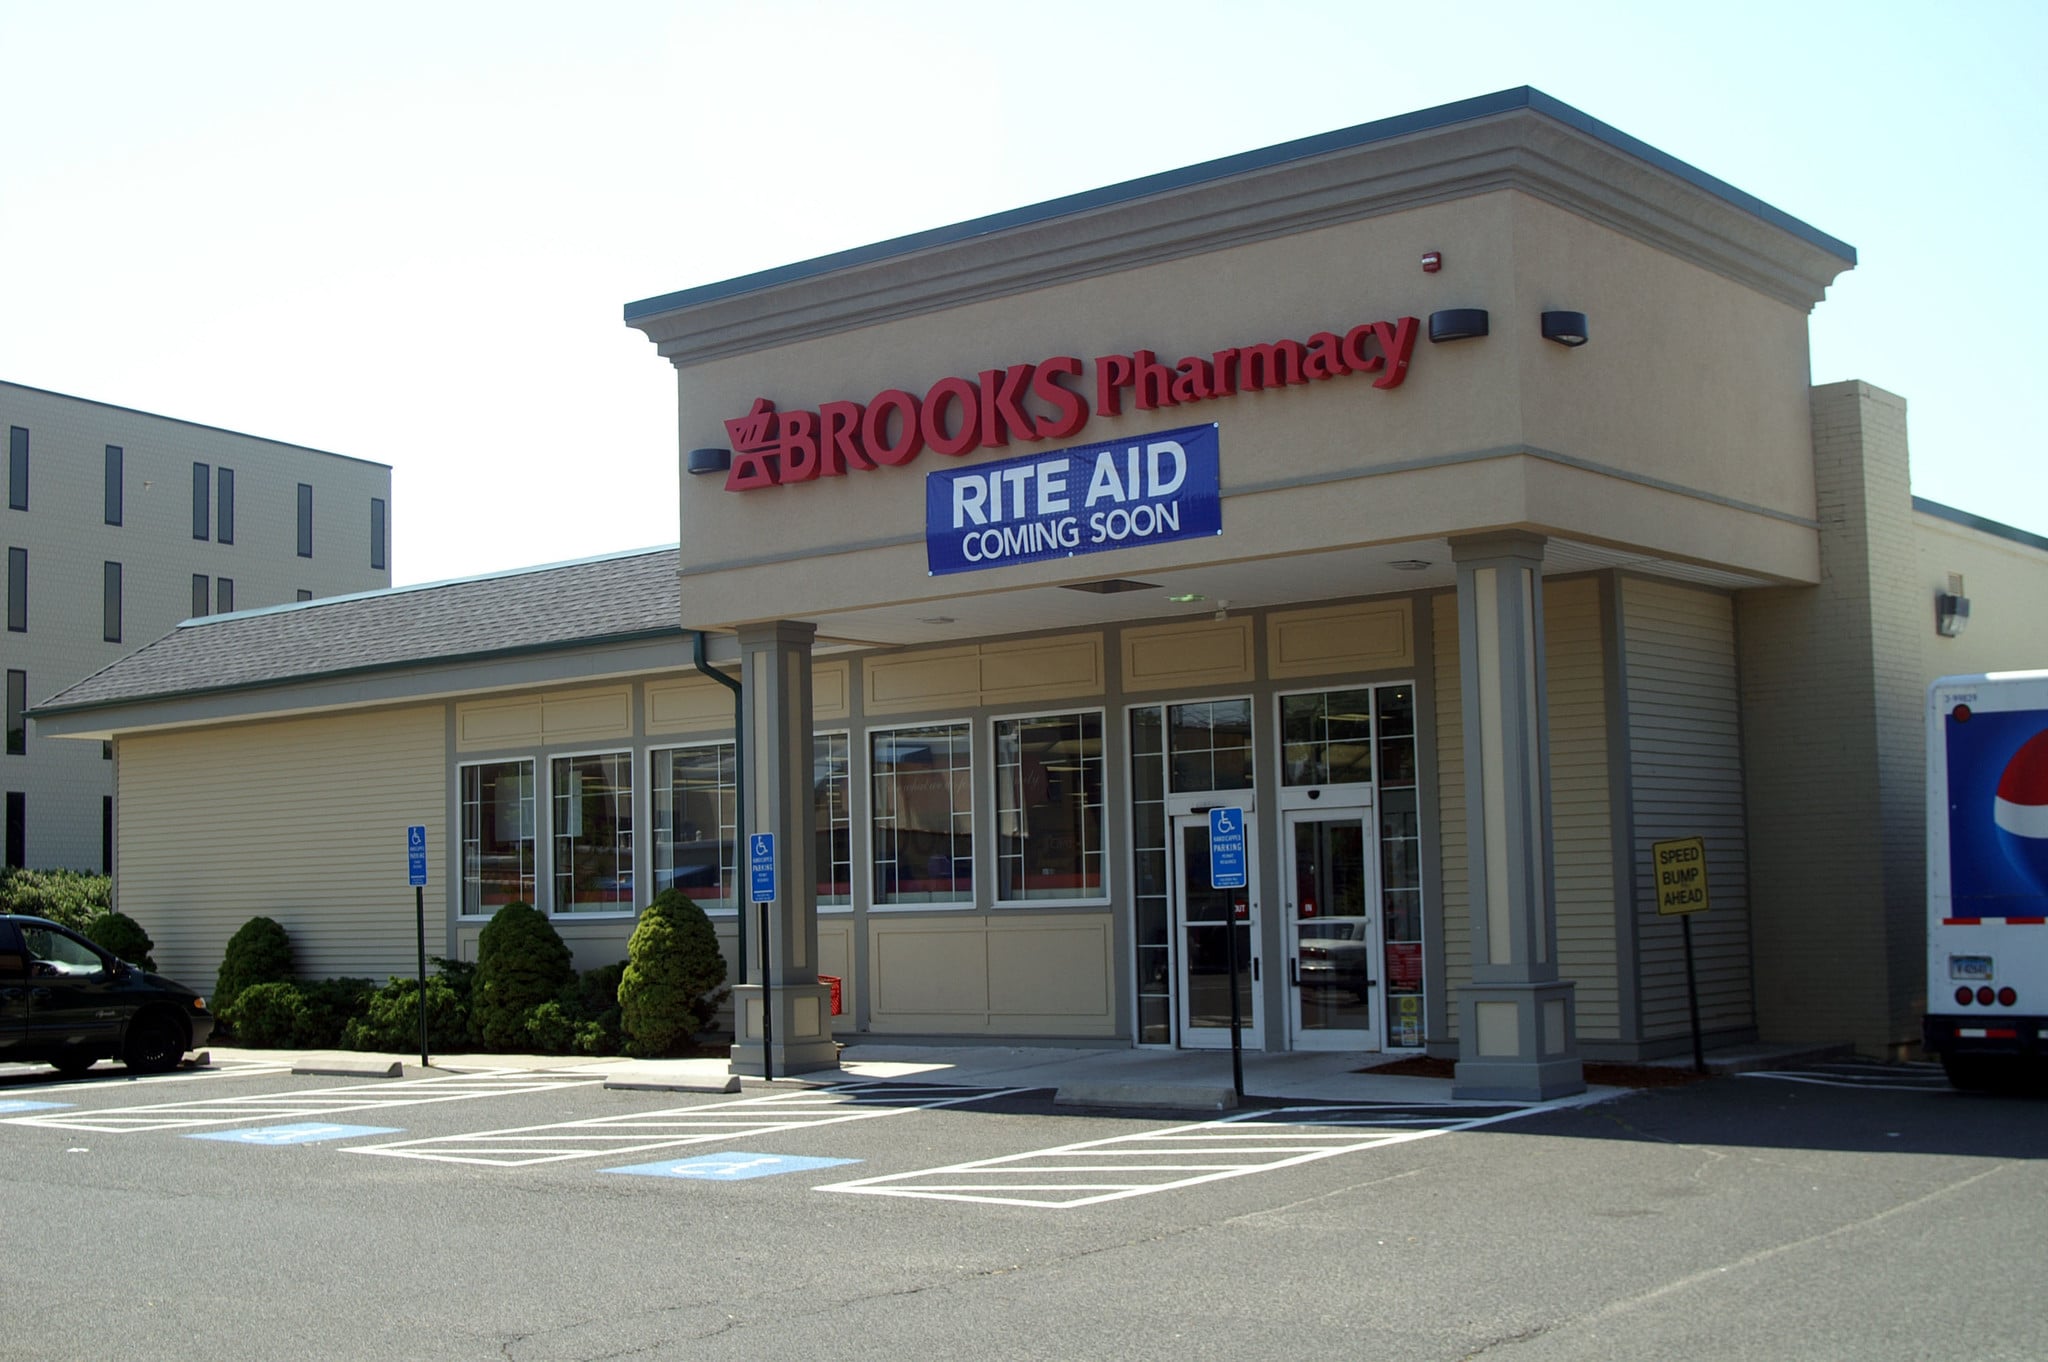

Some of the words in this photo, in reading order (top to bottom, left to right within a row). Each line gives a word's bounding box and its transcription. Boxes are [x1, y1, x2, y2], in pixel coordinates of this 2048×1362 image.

[779, 356, 1090, 484] BROOKS
[1094, 316, 1420, 417] Pharmacy
[953, 458, 1070, 528] RITE
[1084, 440, 1188, 507] AID
[962, 517, 1080, 562] COMING
[1090, 500, 1180, 543] SOON
[1213, 843, 1241, 852] PARKING
[1660, 847, 1699, 865] SPEED
[1662, 867, 1699, 885] BUMP
[1664, 888, 1703, 906] AHEAD
[1305, 904, 1313, 912] IN
